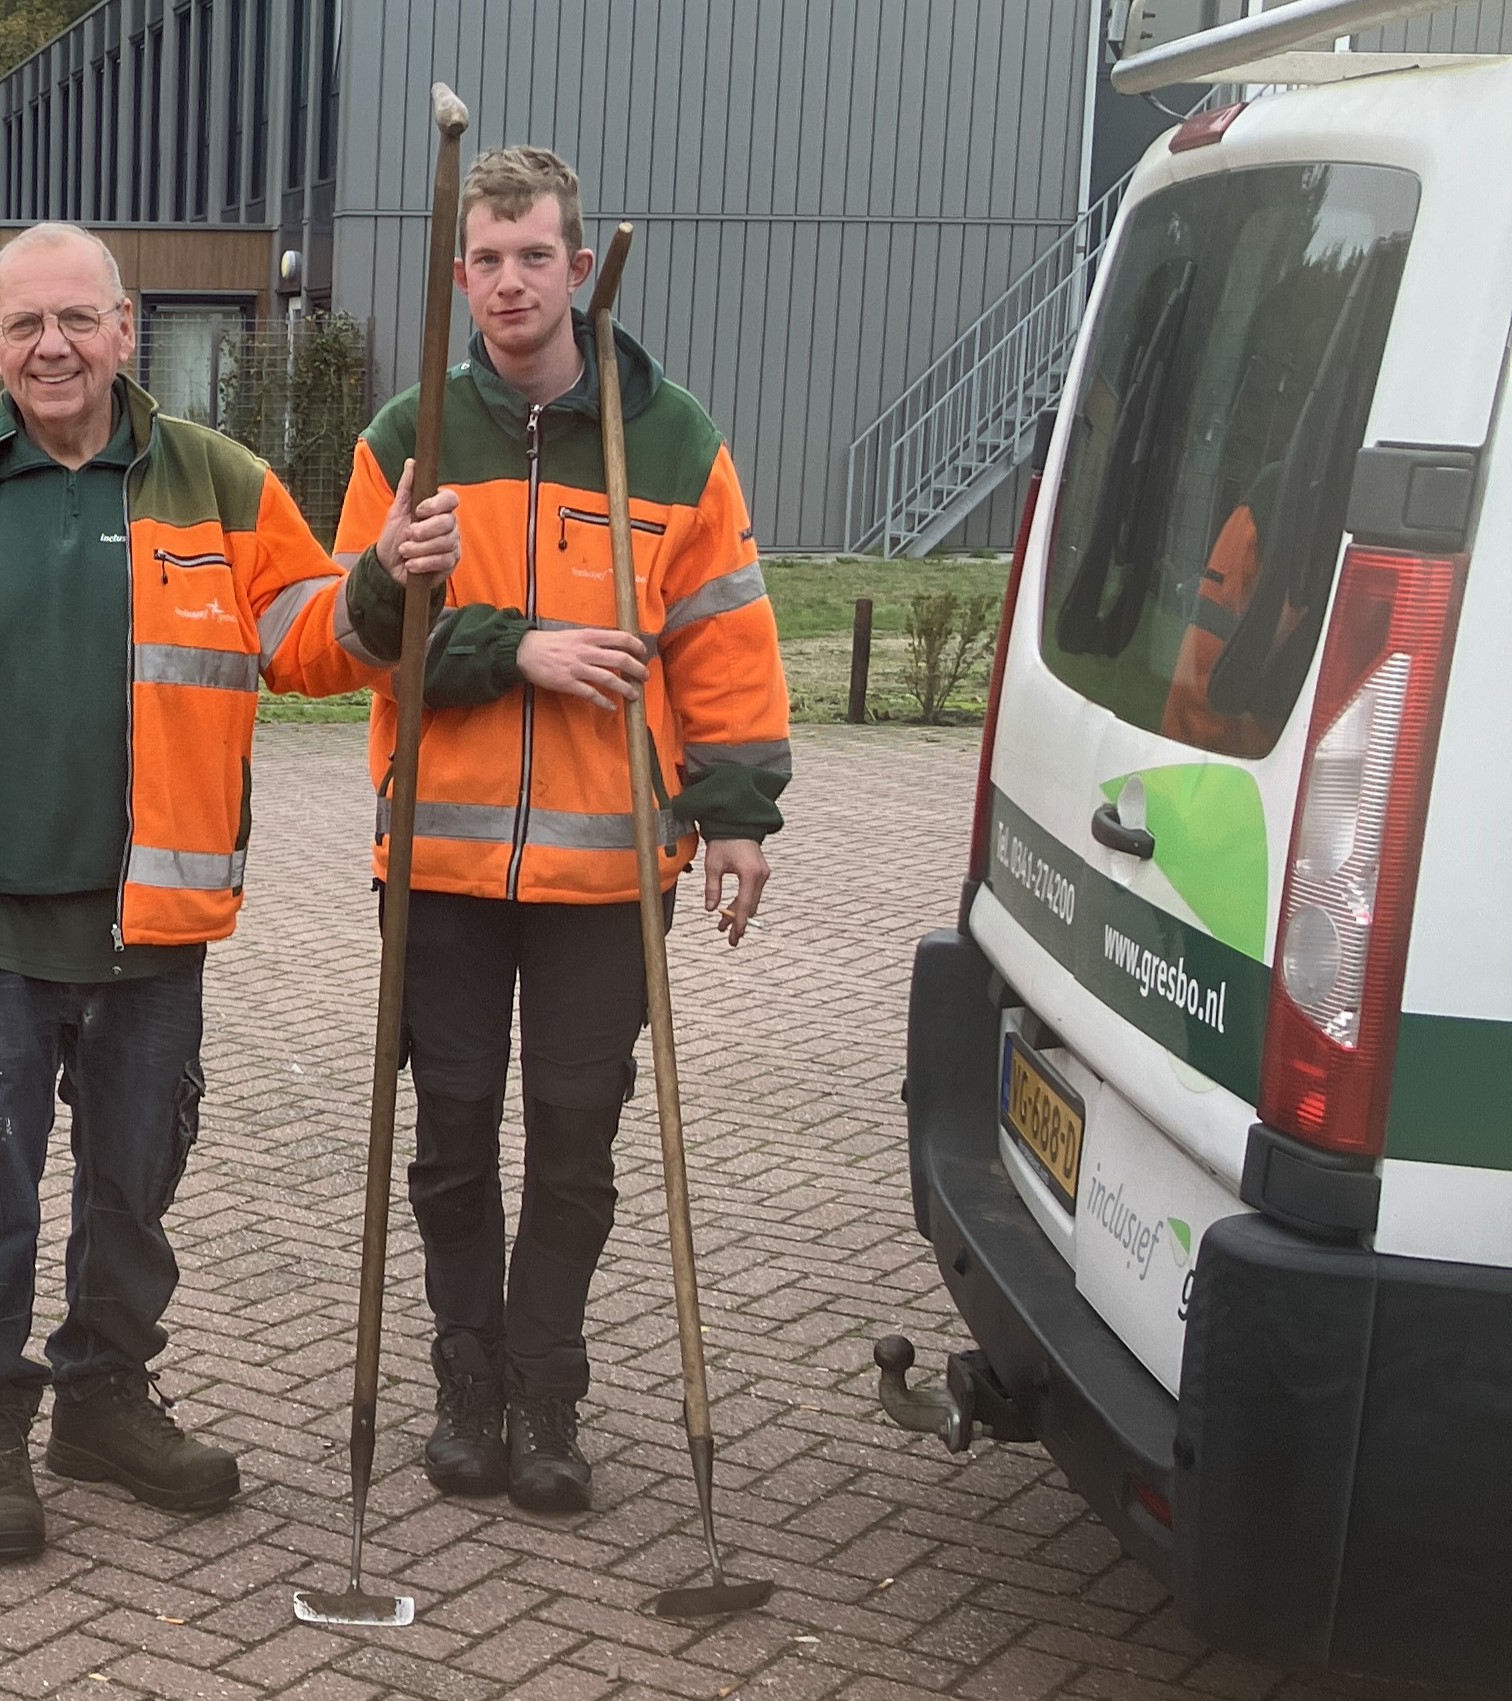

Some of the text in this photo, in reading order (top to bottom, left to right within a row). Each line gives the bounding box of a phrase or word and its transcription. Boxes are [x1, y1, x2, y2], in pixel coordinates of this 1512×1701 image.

[1011, 836, 1076, 926] 0341-274200
[1104, 923, 1227, 1034] www.gresbo.nl
[1086, 1162, 1164, 1281] inclusief
